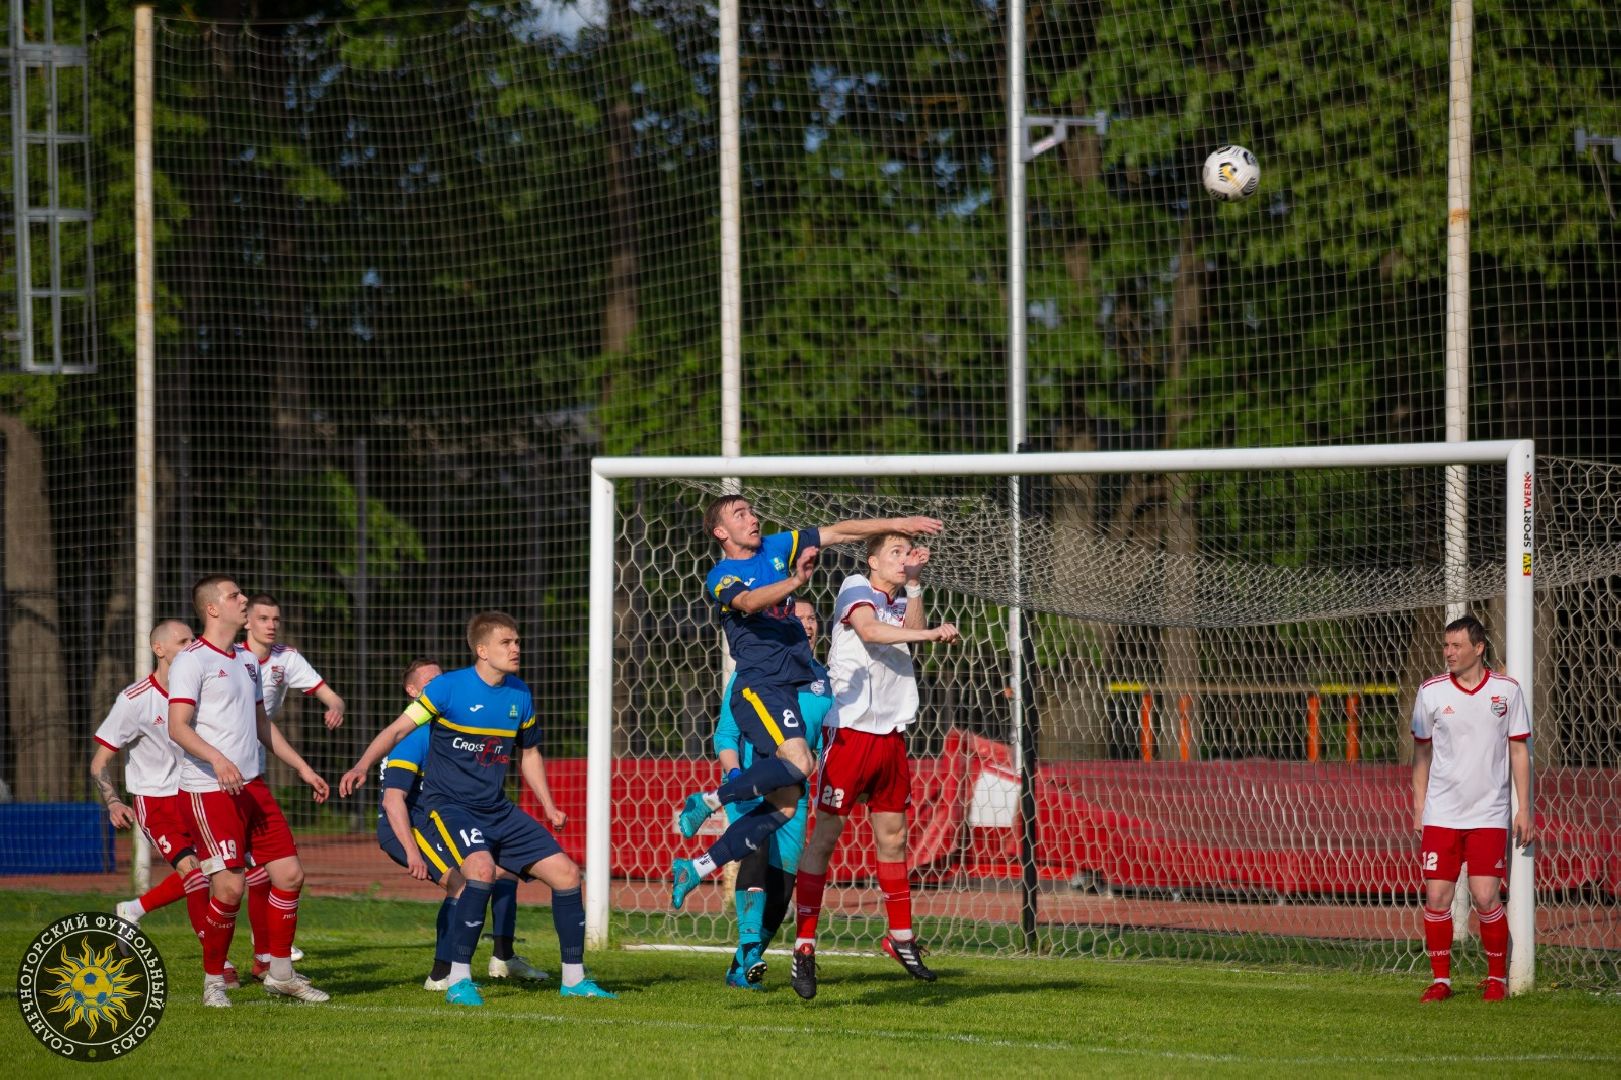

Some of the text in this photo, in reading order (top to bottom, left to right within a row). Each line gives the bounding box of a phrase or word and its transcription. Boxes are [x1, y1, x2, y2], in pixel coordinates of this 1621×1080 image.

[1523, 474, 1532, 547] SPORTWERK
[782, 709, 799, 728] 8
[821, 785, 845, 809] 22
[158, 834, 172, 854] 3
[460, 828, 485, 847] 18
[219, 839, 237, 861] 19
[1422, 851, 1438, 871] 12
